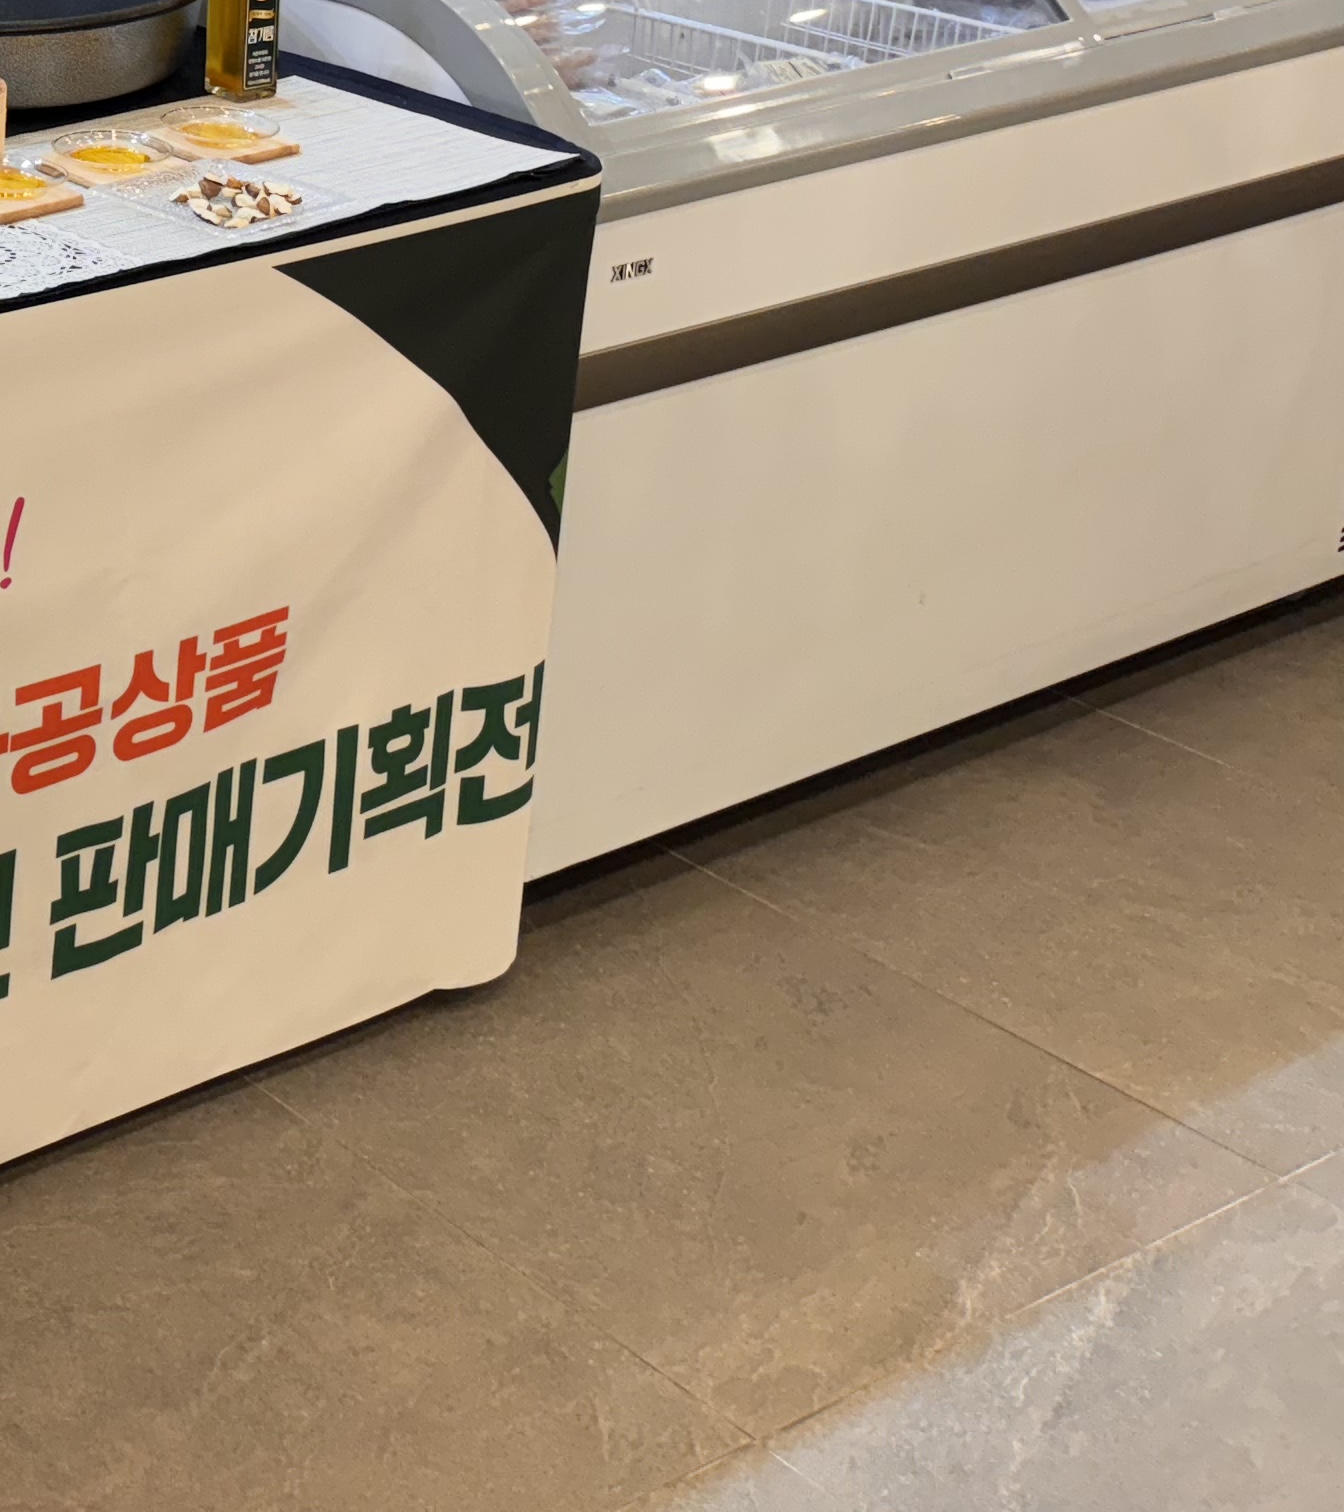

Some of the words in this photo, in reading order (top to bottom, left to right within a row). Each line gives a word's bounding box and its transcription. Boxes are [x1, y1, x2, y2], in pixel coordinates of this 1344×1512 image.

[248, 25, 274, 45] 참기름
[609, 256, 655, 283] XINGX
[47, 658, 546, 966] 판매기획전
